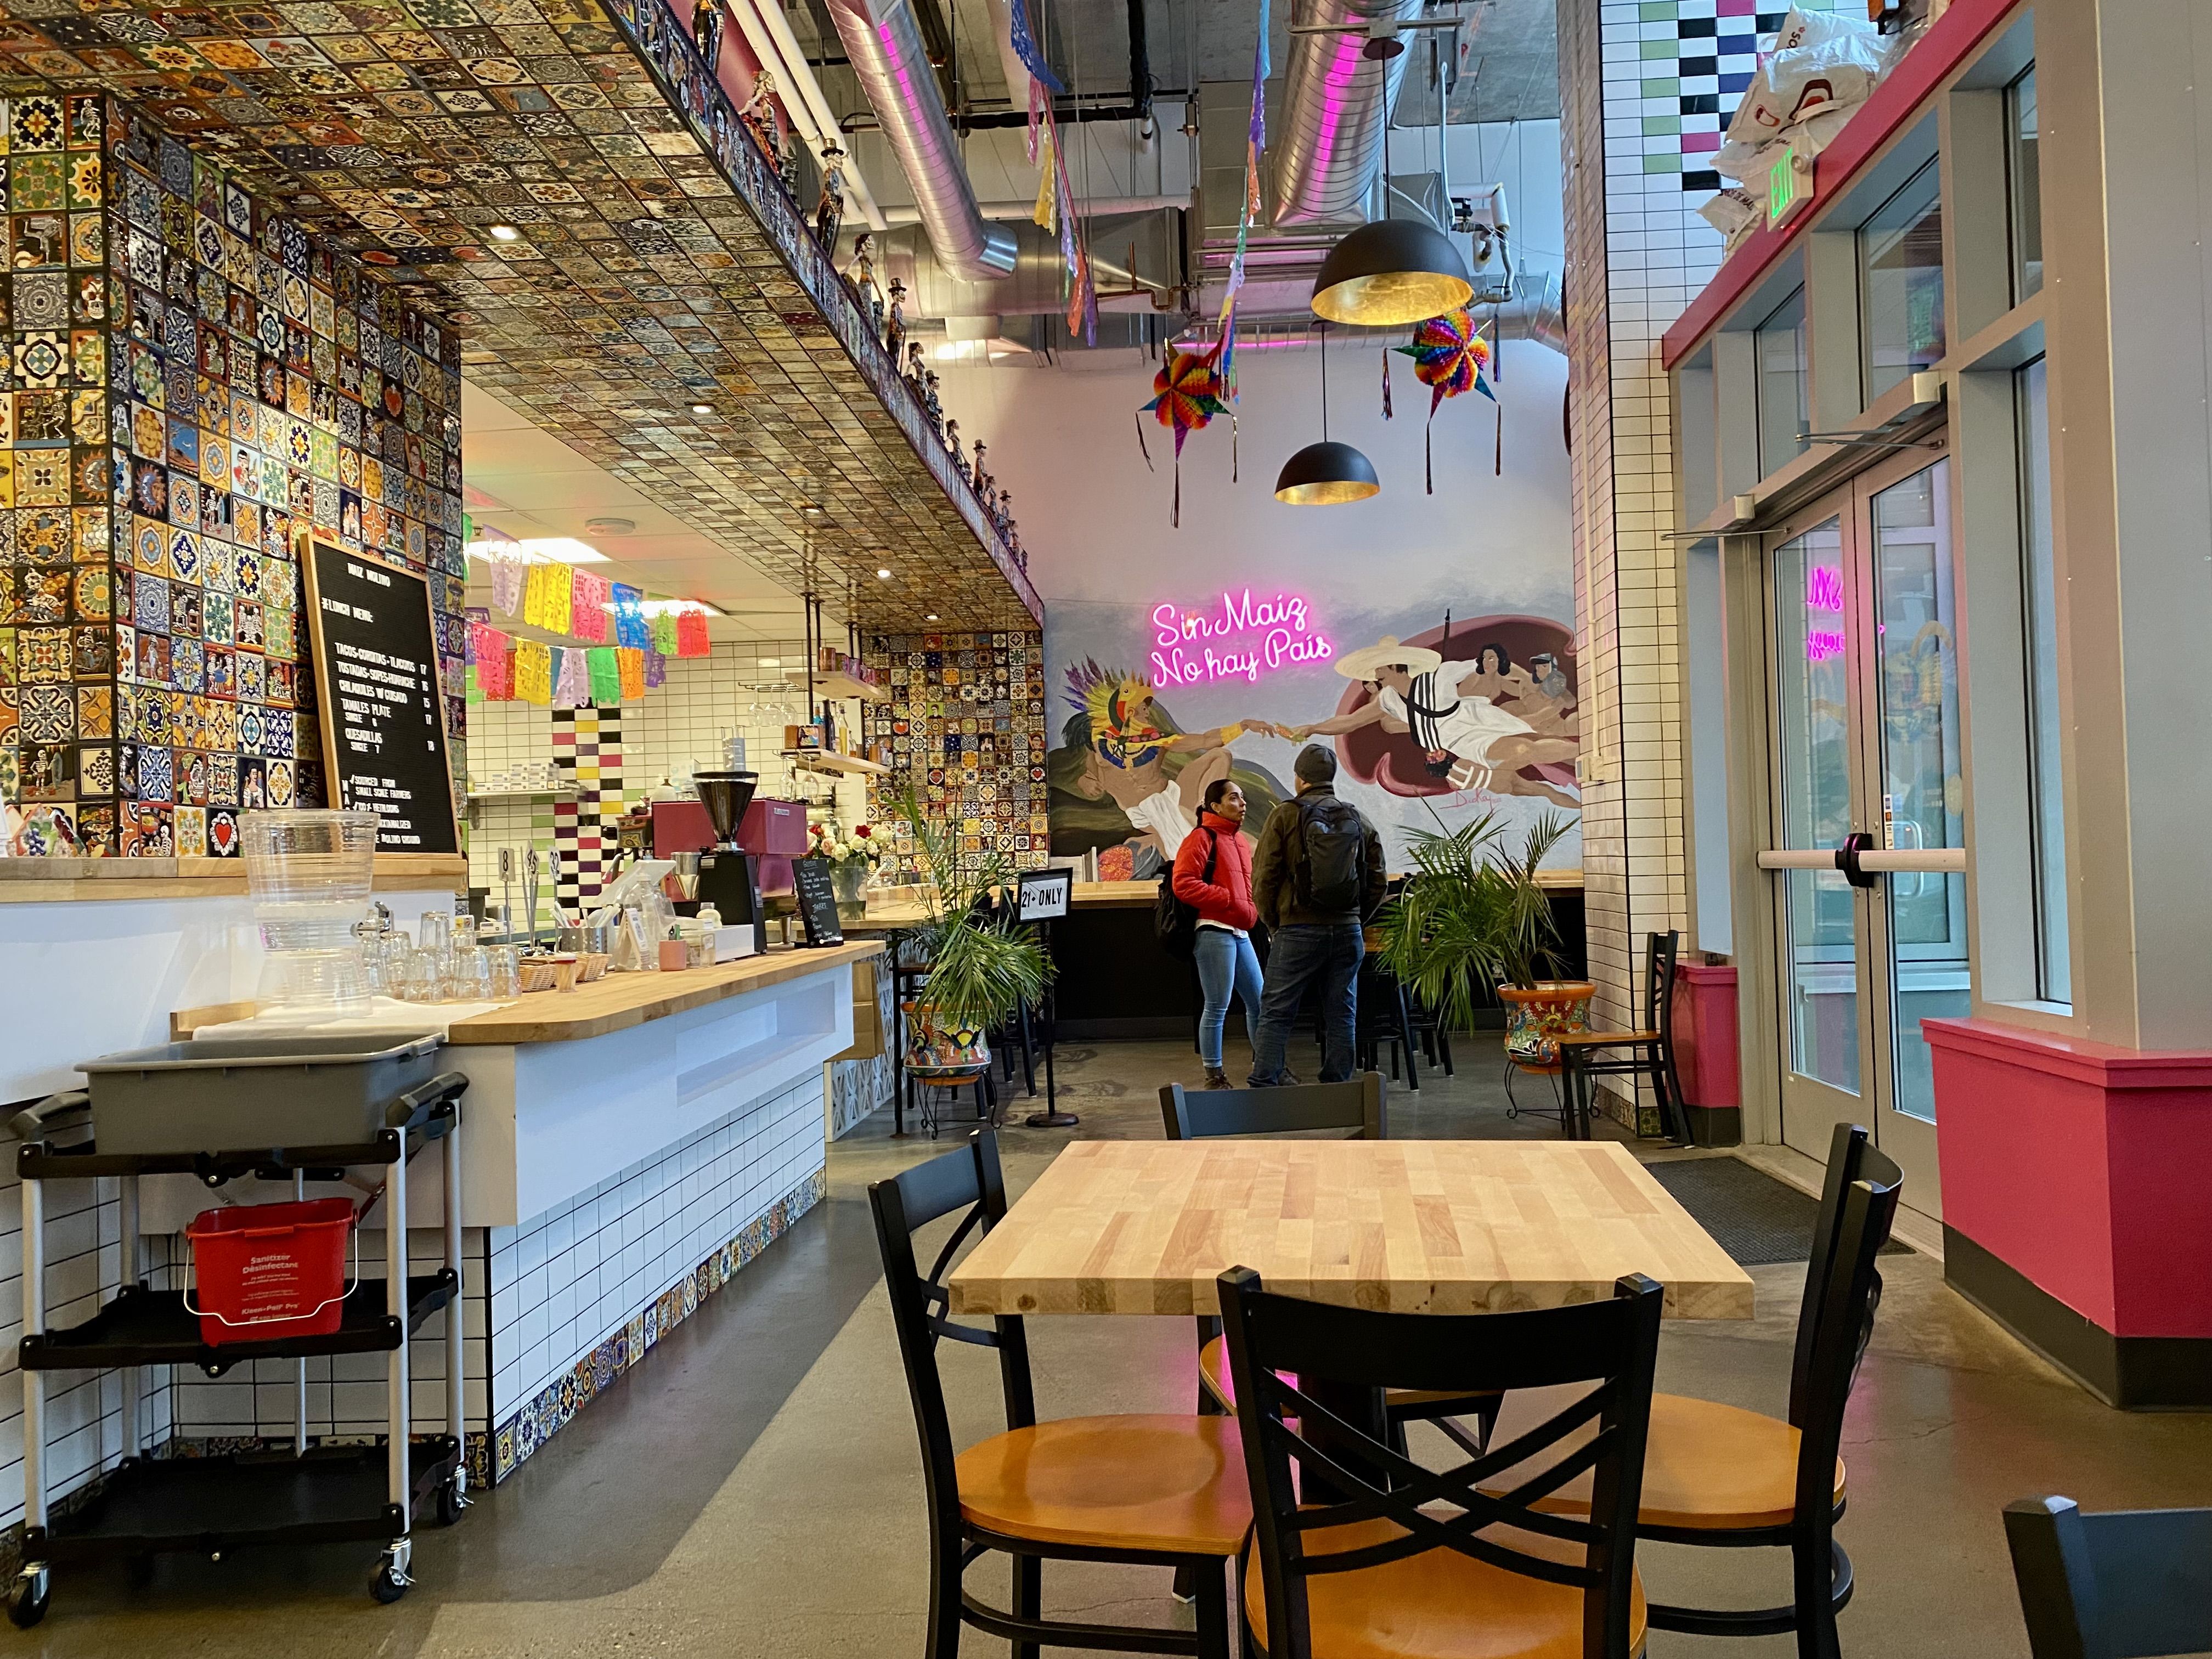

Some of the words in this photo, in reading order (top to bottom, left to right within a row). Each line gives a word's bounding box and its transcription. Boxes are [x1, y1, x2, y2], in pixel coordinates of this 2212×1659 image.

[1787, 31, 1801, 48] OS
[1770, 146, 1793, 219] EXIT
[366, 569, 391, 587] MOLINO
[1153, 604, 1213, 646] Sin
[420, 664, 427, 675] 17
[1150, 647, 1204, 687] No
[1204, 648, 1260, 681] hay
[341, 698, 370, 714] TAMALES
[371, 703, 392, 718] PLATE
[422, 697, 431, 709] 15
[345, 727, 383, 744] QUESADILLAS
[355, 786, 373, 797] SMALL
[390, 789, 411, 800] FARMERS
[503, 850, 509, 872] 8
[1039, 887, 1063, 906] ONLY
[251, 1255, 291, 1265] Sanitizer
